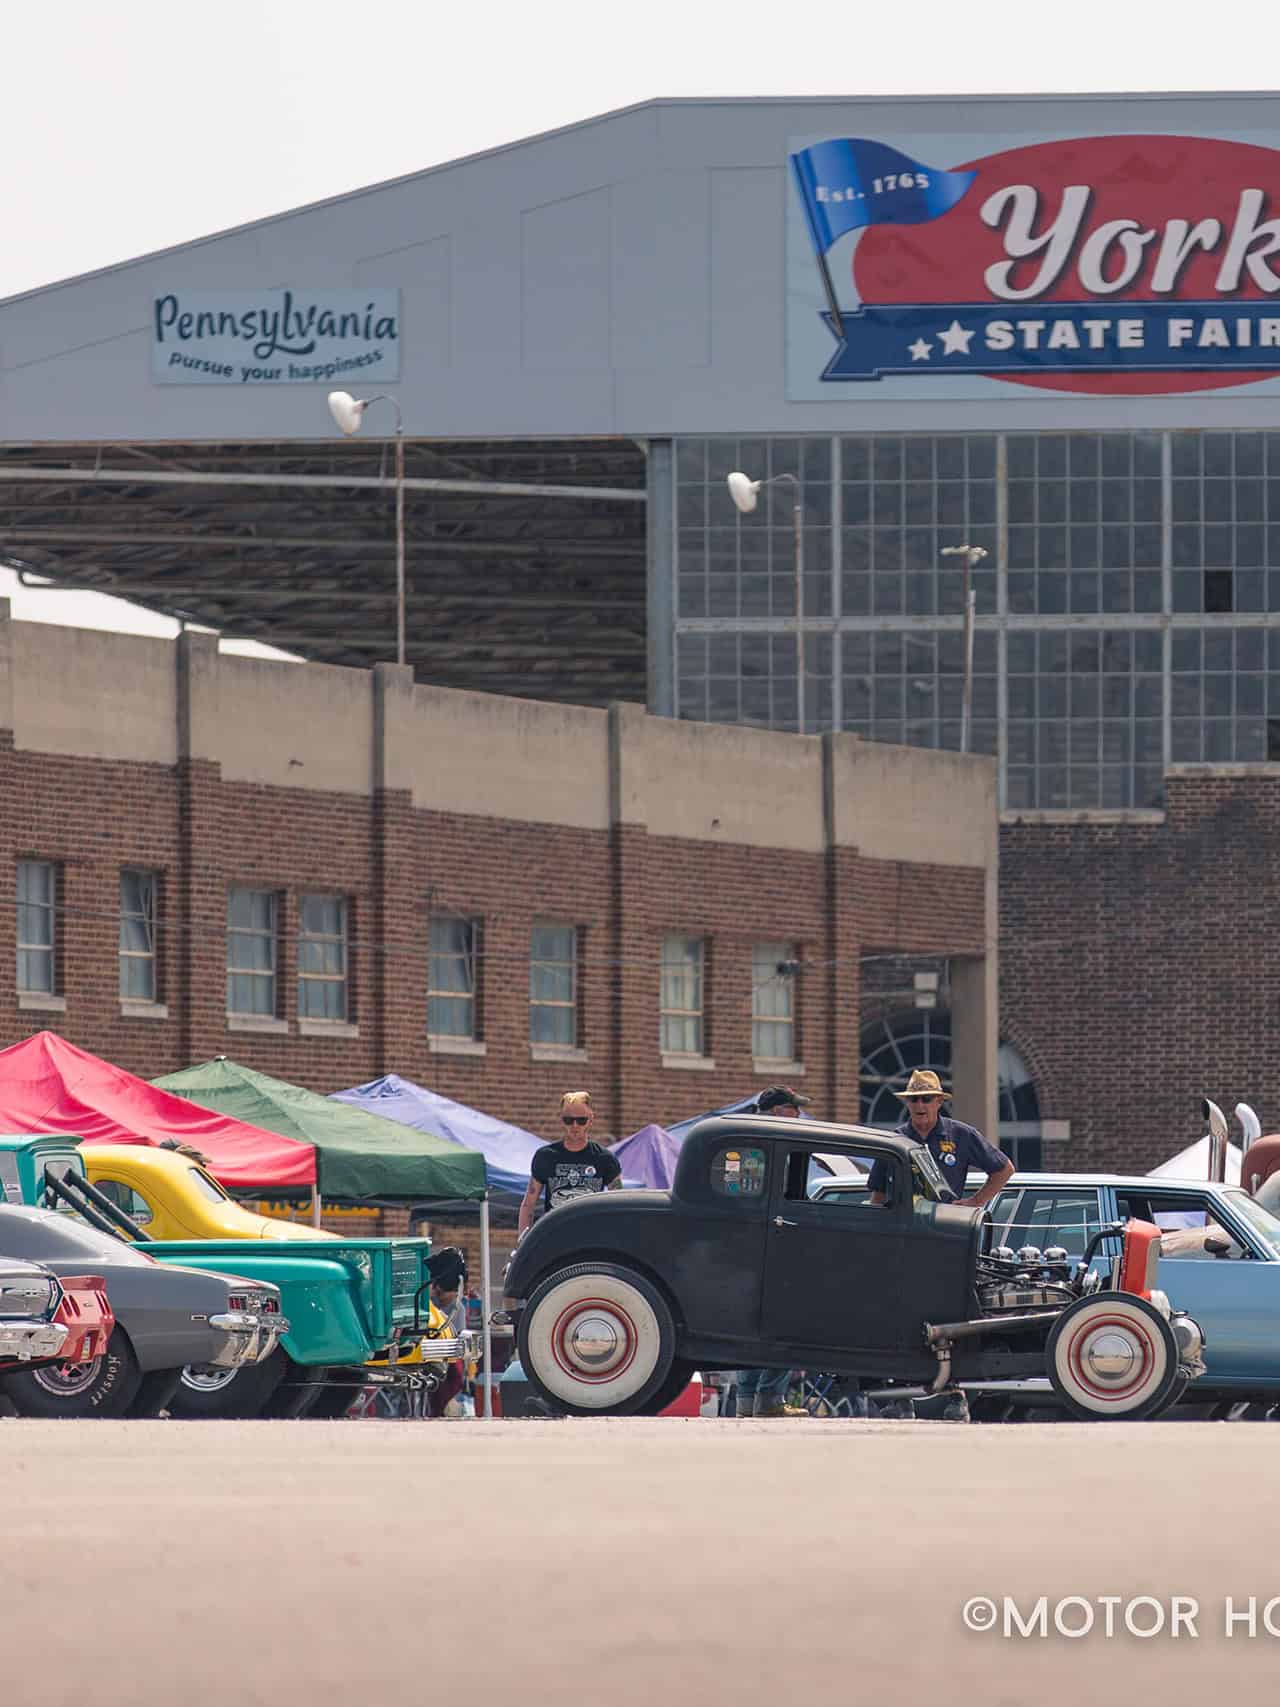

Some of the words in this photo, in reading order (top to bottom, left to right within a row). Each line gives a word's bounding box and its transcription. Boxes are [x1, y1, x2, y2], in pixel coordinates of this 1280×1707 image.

[816, 185, 865, 203] Est.
[872, 172, 929, 193] 1765
[154, 290, 397, 360] Pennsylvania
[985, 319, 1145, 351] STATE
[168, 351, 233, 378] pursue
[240, 364, 282, 382] your
[288, 349, 384, 380] happiness
